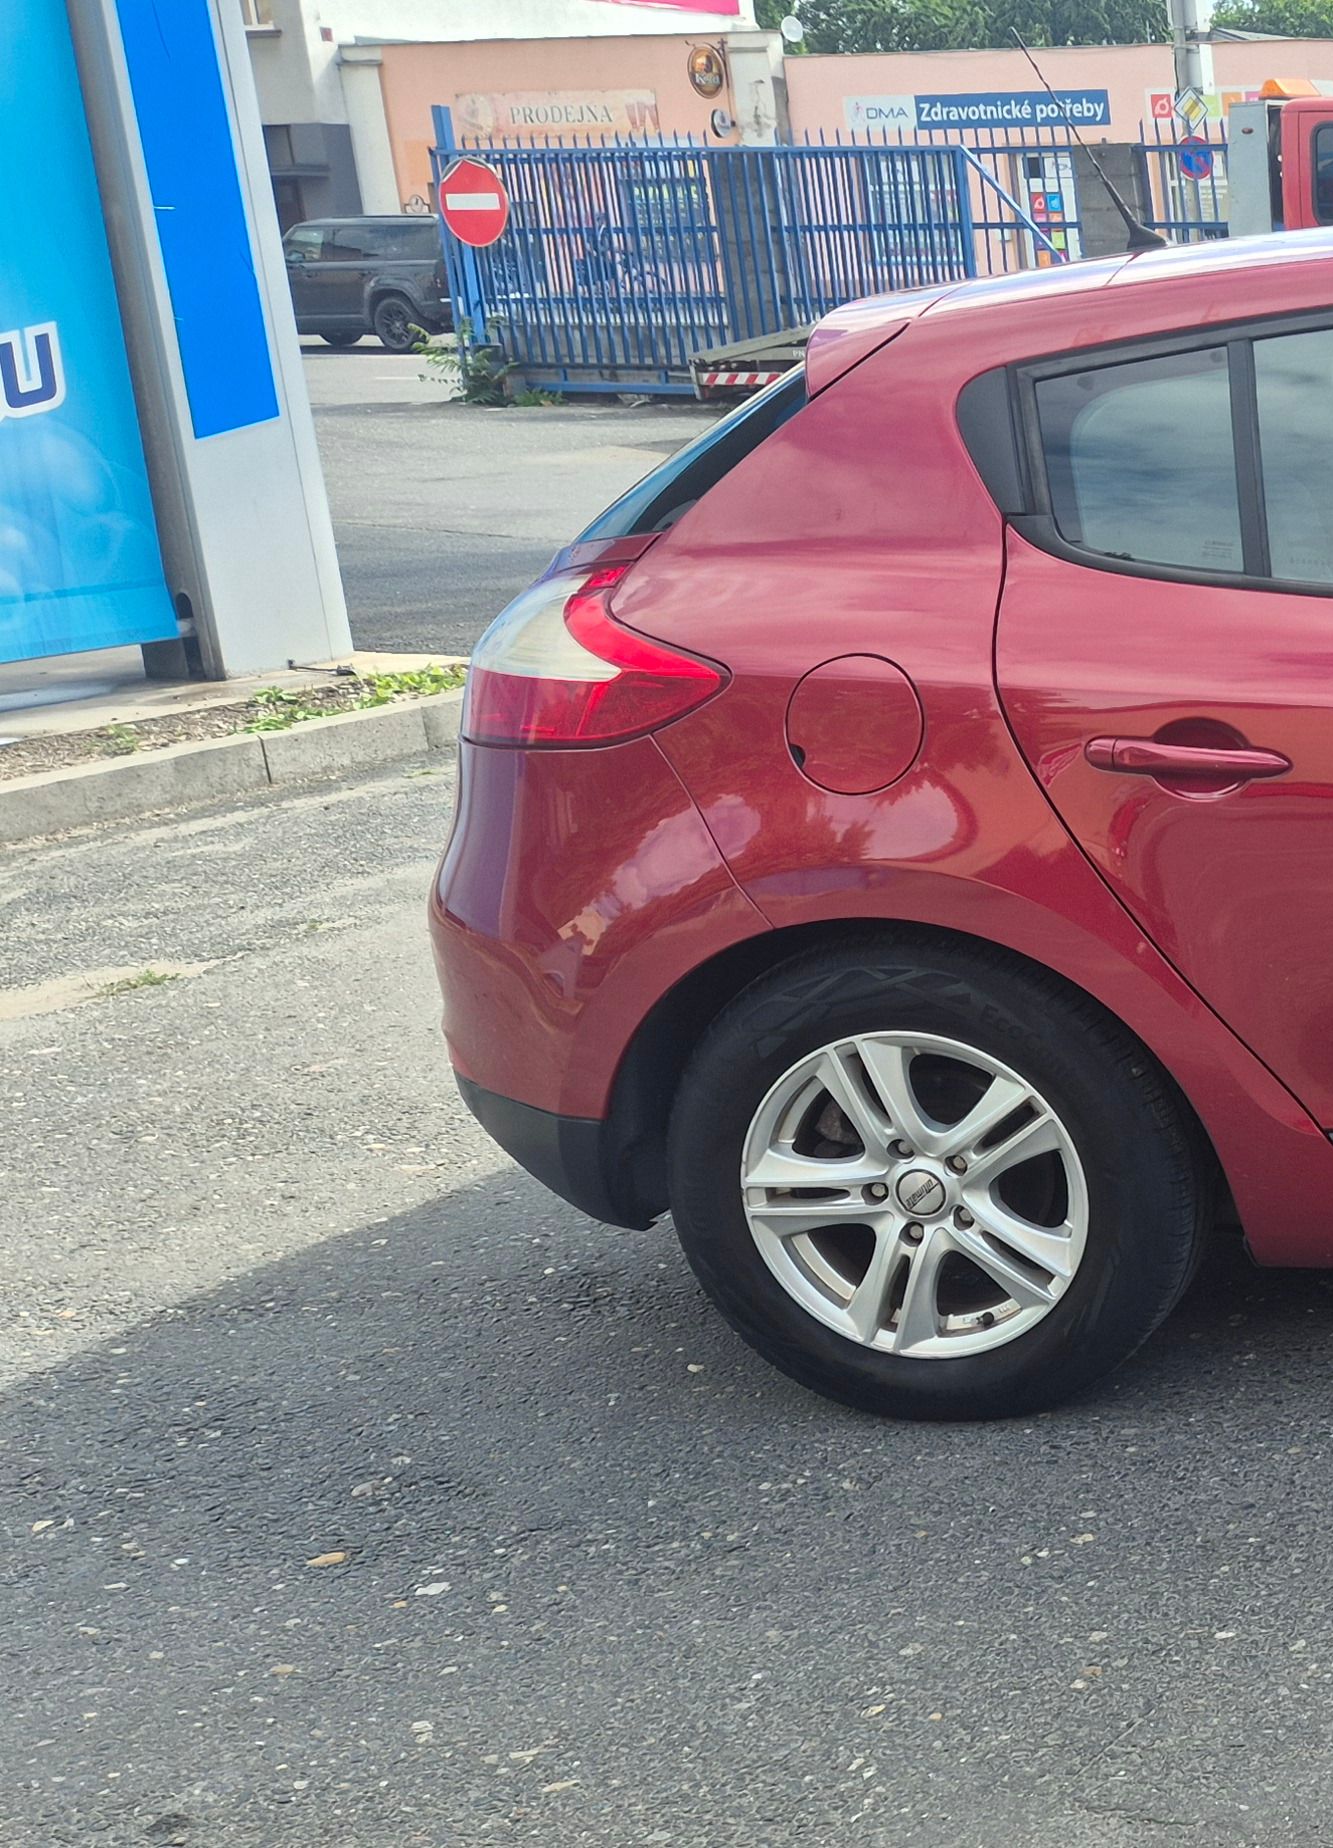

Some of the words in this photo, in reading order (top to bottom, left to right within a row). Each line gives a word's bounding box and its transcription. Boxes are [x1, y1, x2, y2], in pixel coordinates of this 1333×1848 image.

[509, 104, 614, 125] PRODEJNA
[866, 105, 909, 120] DMA
[918, 98, 1032, 122] Zdravotnické
[1035, 97, 1105, 123] potřeby
